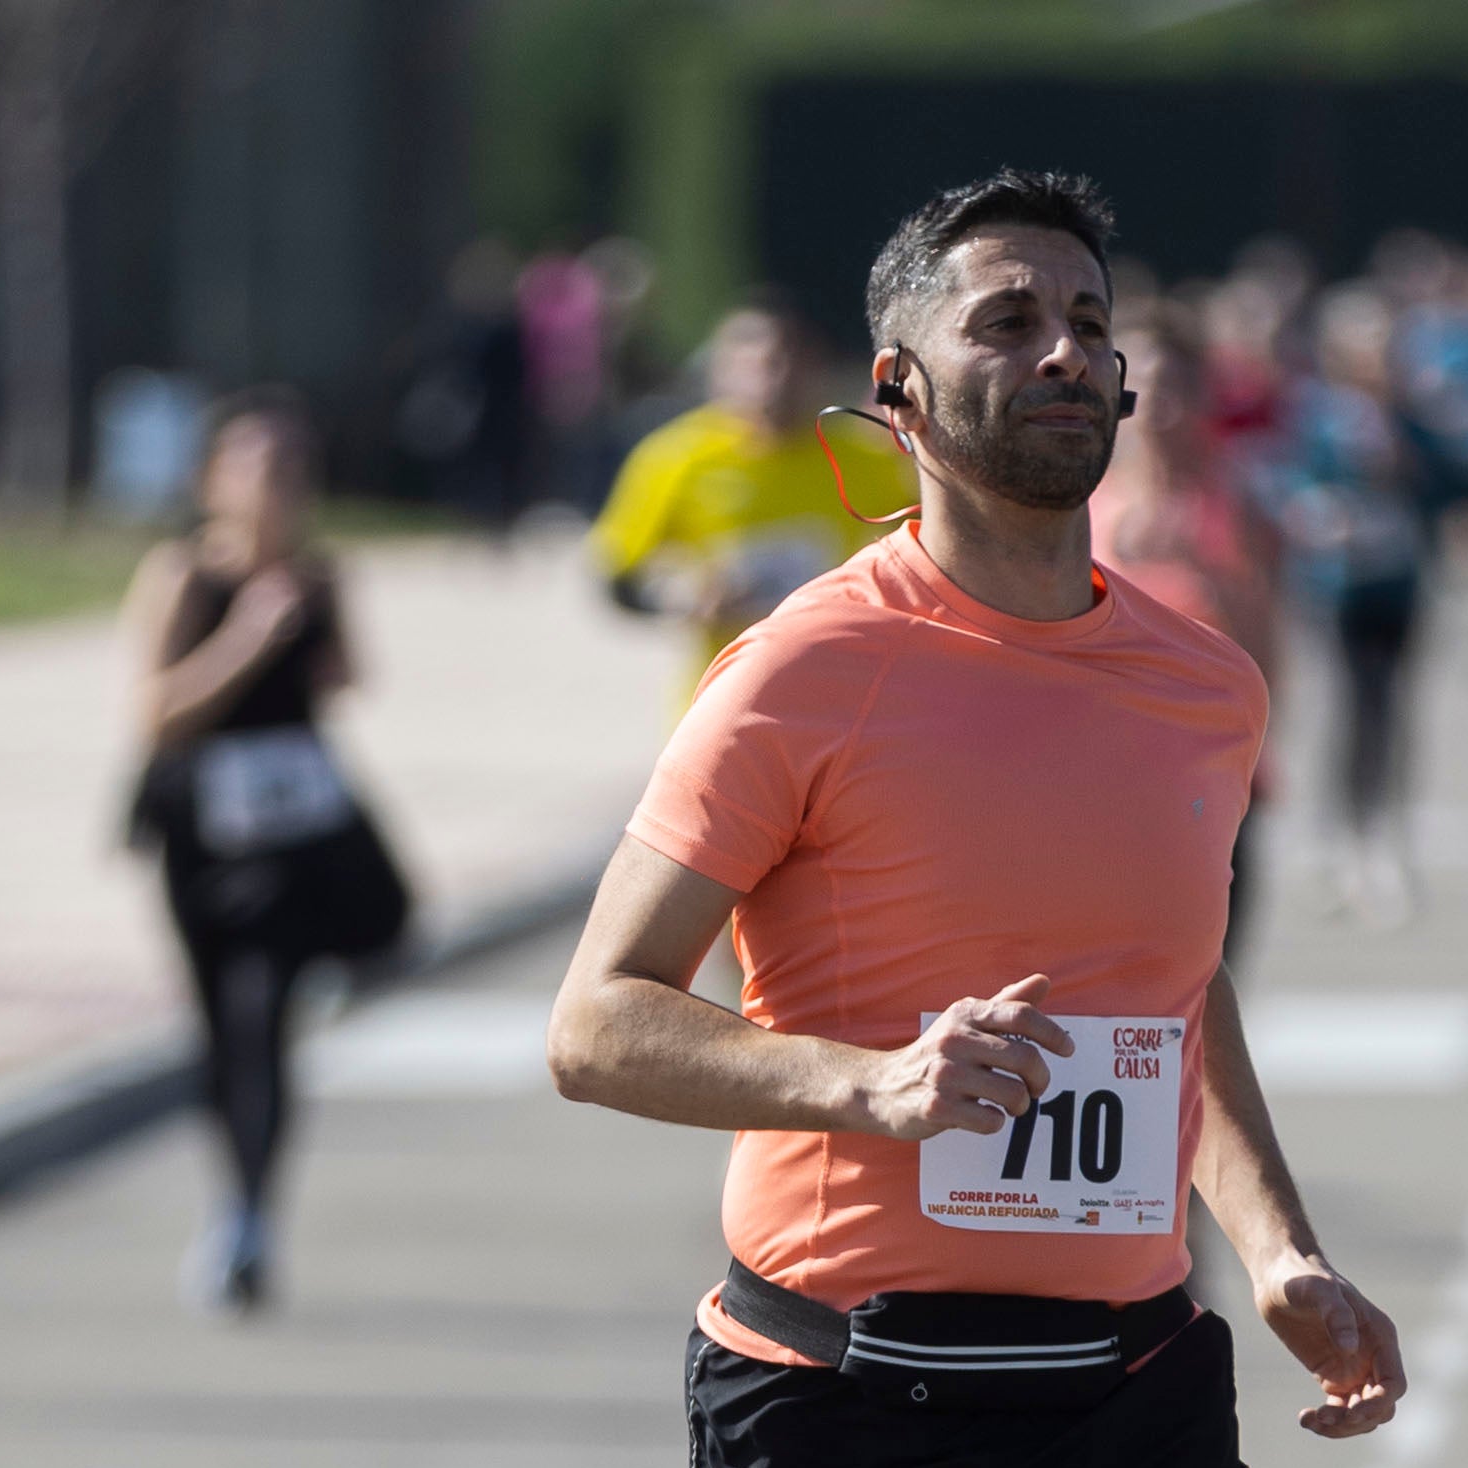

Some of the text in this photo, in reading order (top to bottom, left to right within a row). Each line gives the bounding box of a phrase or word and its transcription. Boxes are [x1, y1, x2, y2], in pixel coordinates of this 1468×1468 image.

[1113, 1027, 1163, 1051] CORRE
[1114, 1057, 1160, 1079] CAUSA
[1000, 1089, 1123, 1183] 710
[949, 1191, 1039, 1204] CORRE POR LA
[927, 1203, 1059, 1219] INFANCIA REFUGIADA
